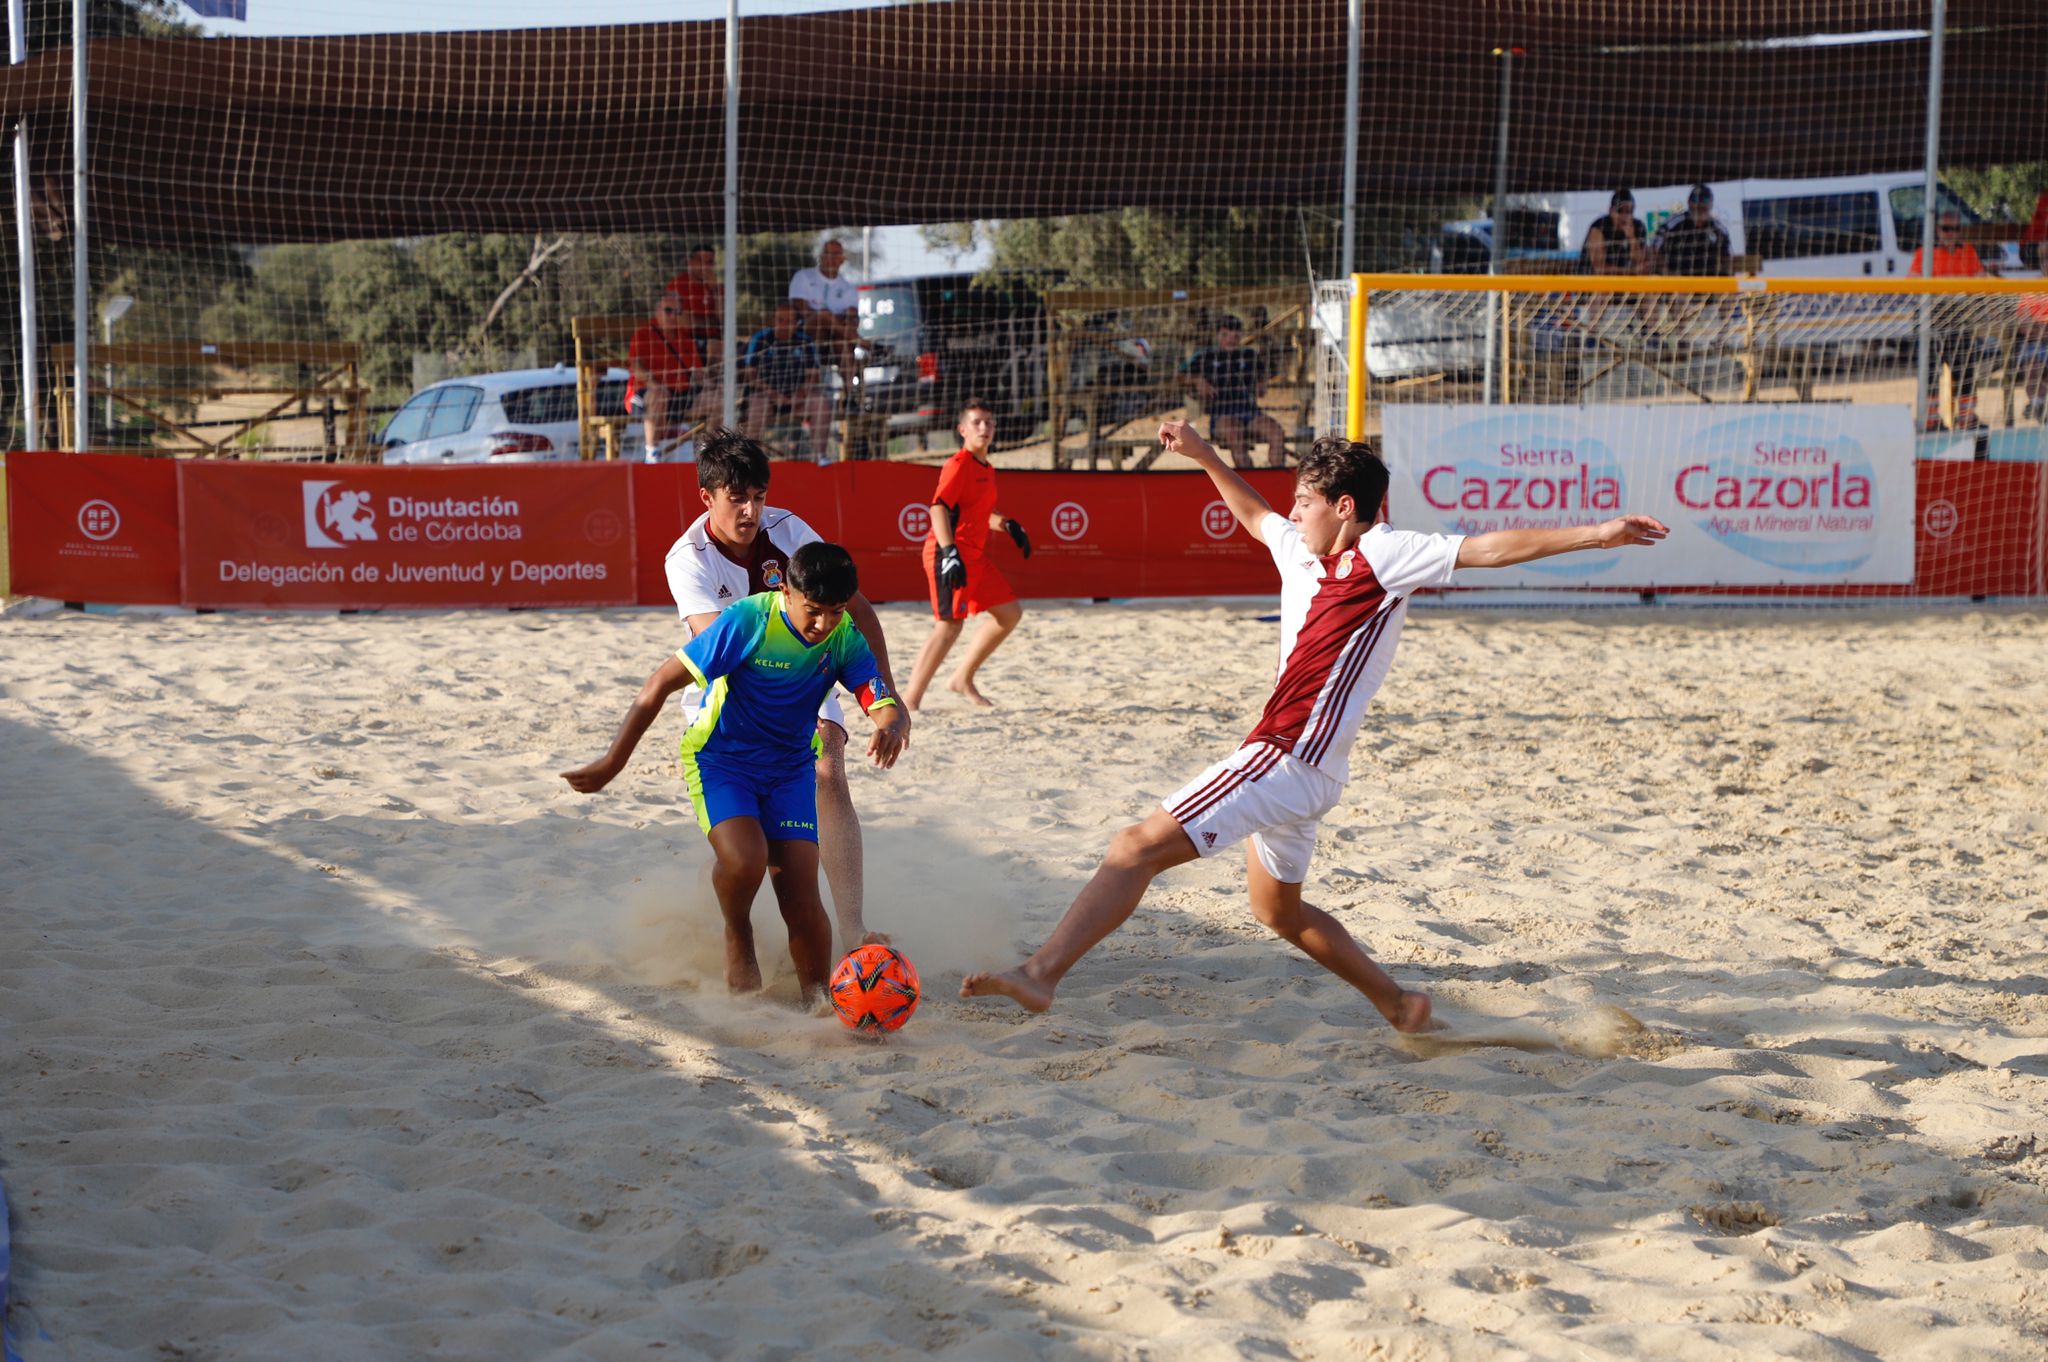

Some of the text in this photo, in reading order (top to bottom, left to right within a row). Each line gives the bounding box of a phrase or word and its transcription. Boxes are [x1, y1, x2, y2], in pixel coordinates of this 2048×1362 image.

[1501, 443, 1574, 466] Sierra
[1755, 442, 1827, 465] Sierra
[1422, 463, 1621, 510] Cazorla
[1675, 461, 1872, 510] Cazorla
[388, 496, 519, 521] Diputación
[389, 521, 522, 541] de Córdoba
[1707, 513, 1874, 537] Agua Mineral Natural
[220, 560, 608, 587] Delegación de Juventud y Deportes
[755, 658, 792, 670] KELME
[780, 820, 815, 831] KELME
